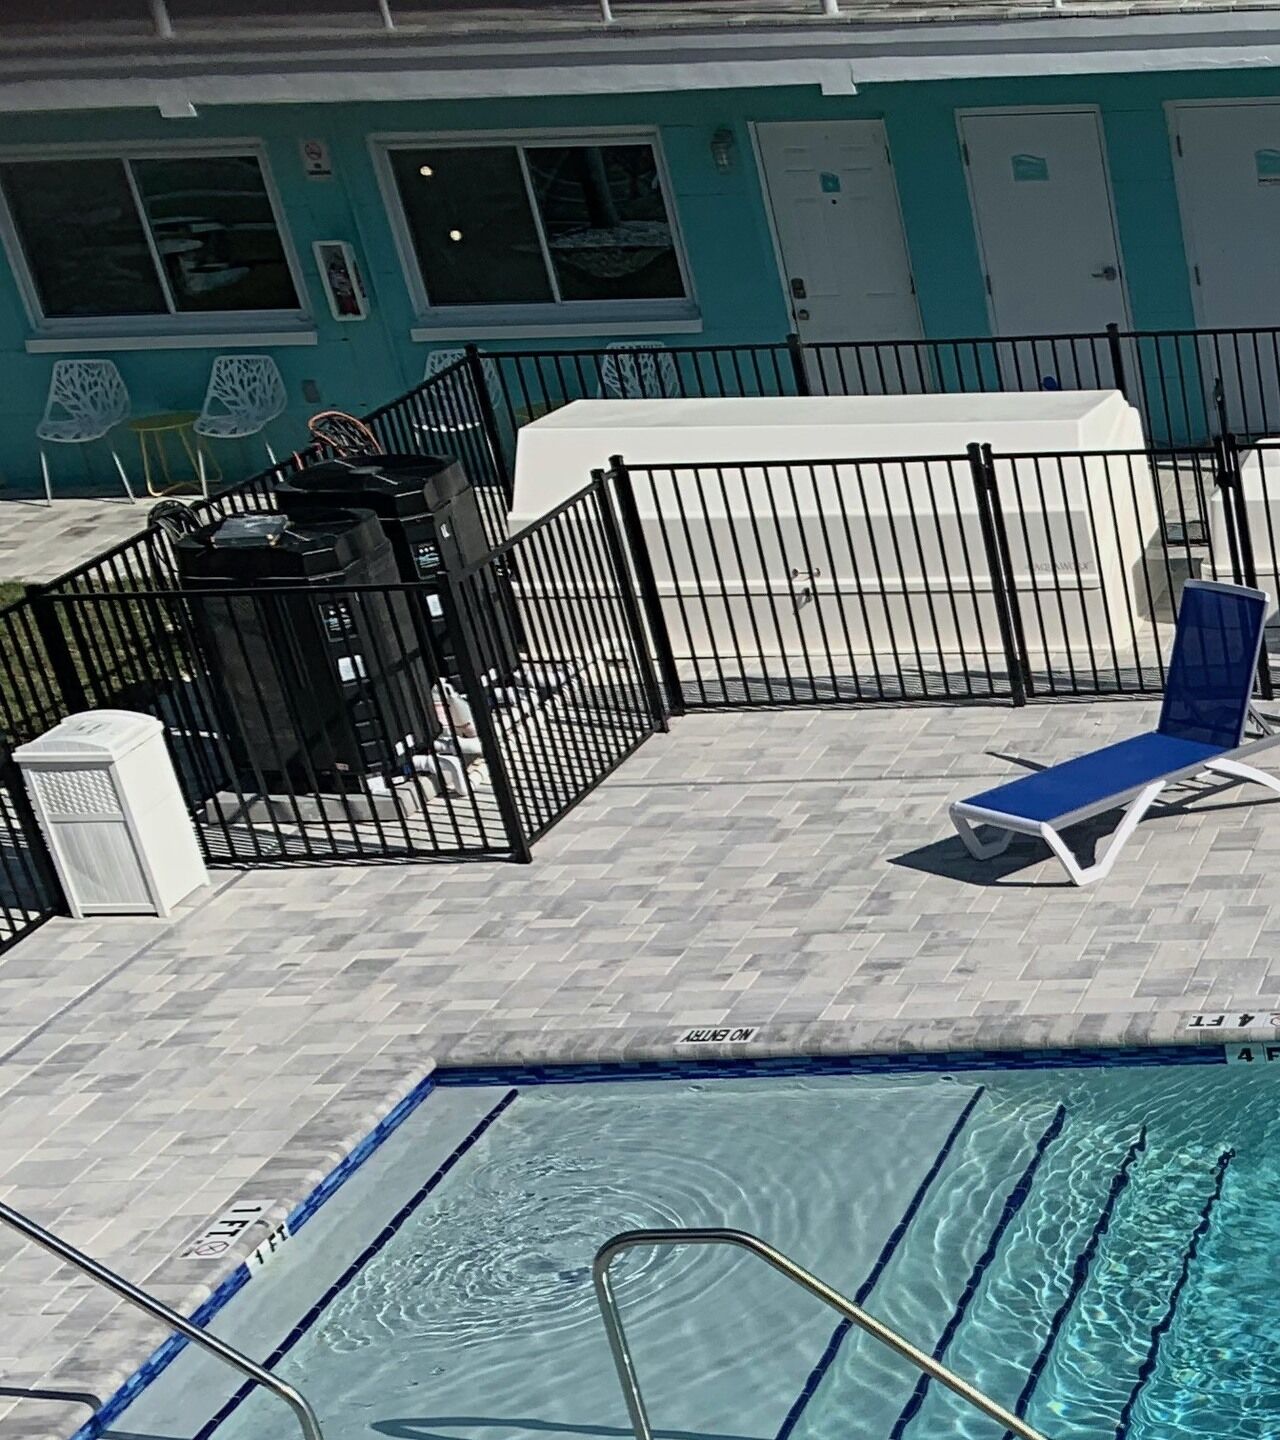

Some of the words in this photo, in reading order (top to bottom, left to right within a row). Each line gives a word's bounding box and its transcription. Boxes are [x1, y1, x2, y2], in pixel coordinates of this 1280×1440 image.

[1238, 1013, 1255, 1027] 4
[680, 1029, 731, 1043] ENTRY
[728, 1028, 755, 1042] NO
[1238, 1047, 1255, 1062] 4
